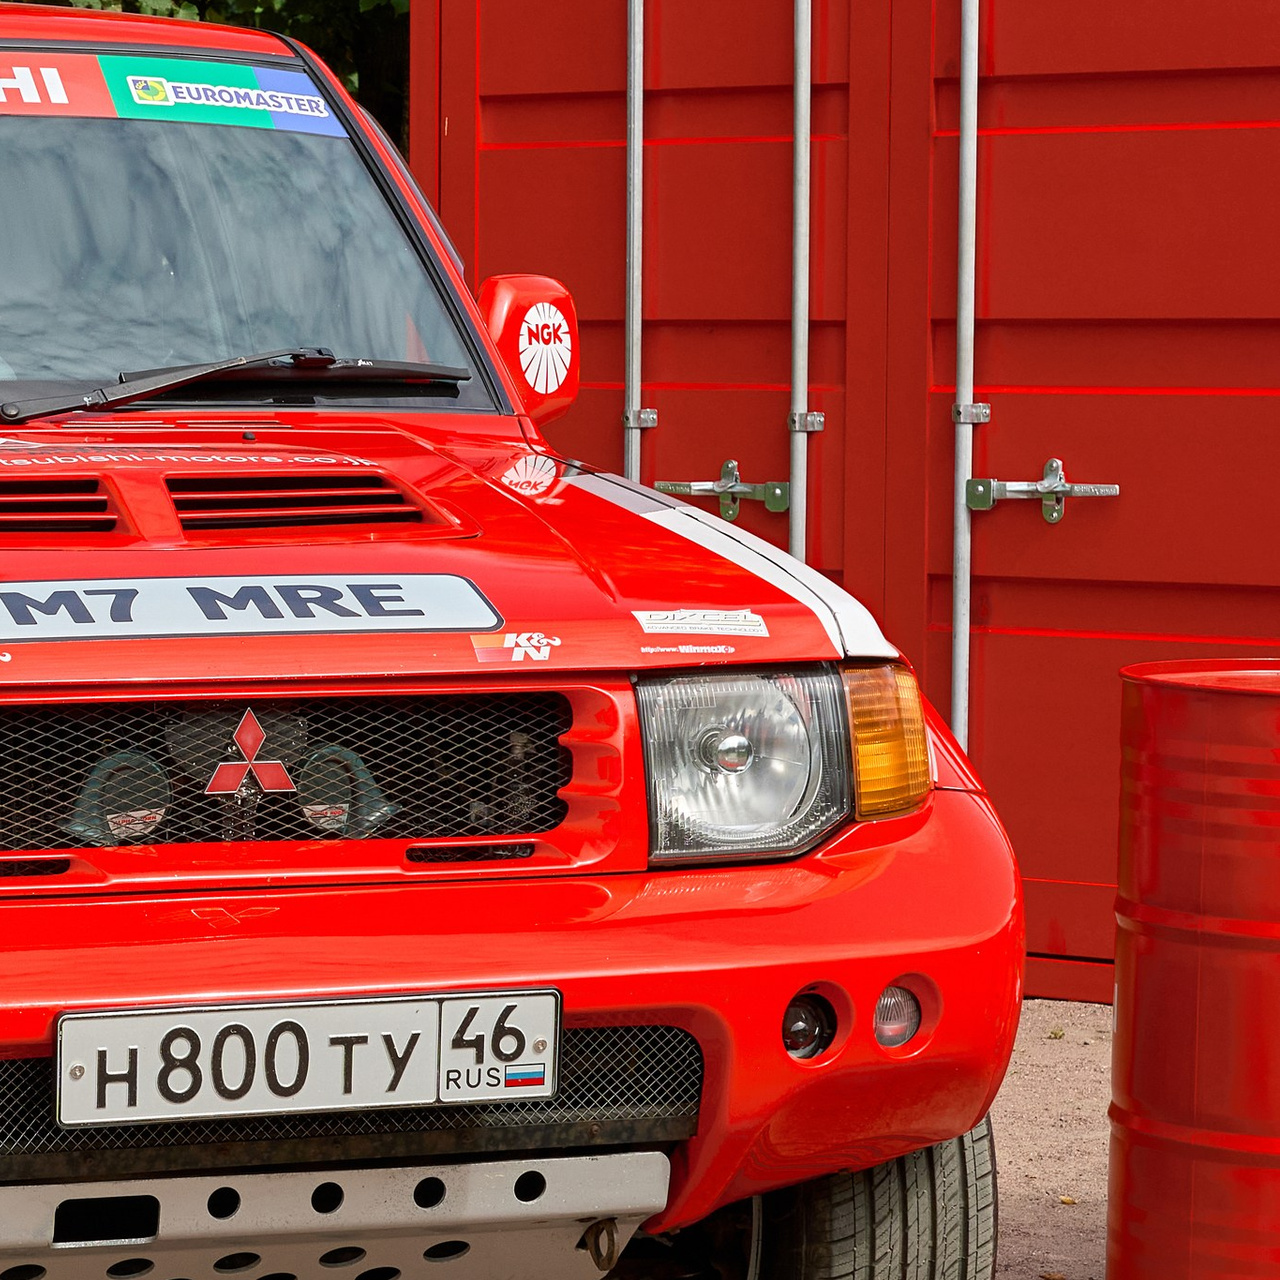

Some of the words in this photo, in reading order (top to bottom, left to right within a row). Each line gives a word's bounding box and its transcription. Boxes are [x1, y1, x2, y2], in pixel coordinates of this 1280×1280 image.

[171, 85, 323, 114] EUROMASTER
[527, 323, 563, 346] NGK
[186, 584, 426, 621] MRE
[451, 1004, 527, 1065] 46
[446, 1066, 502, 1091] RUS
